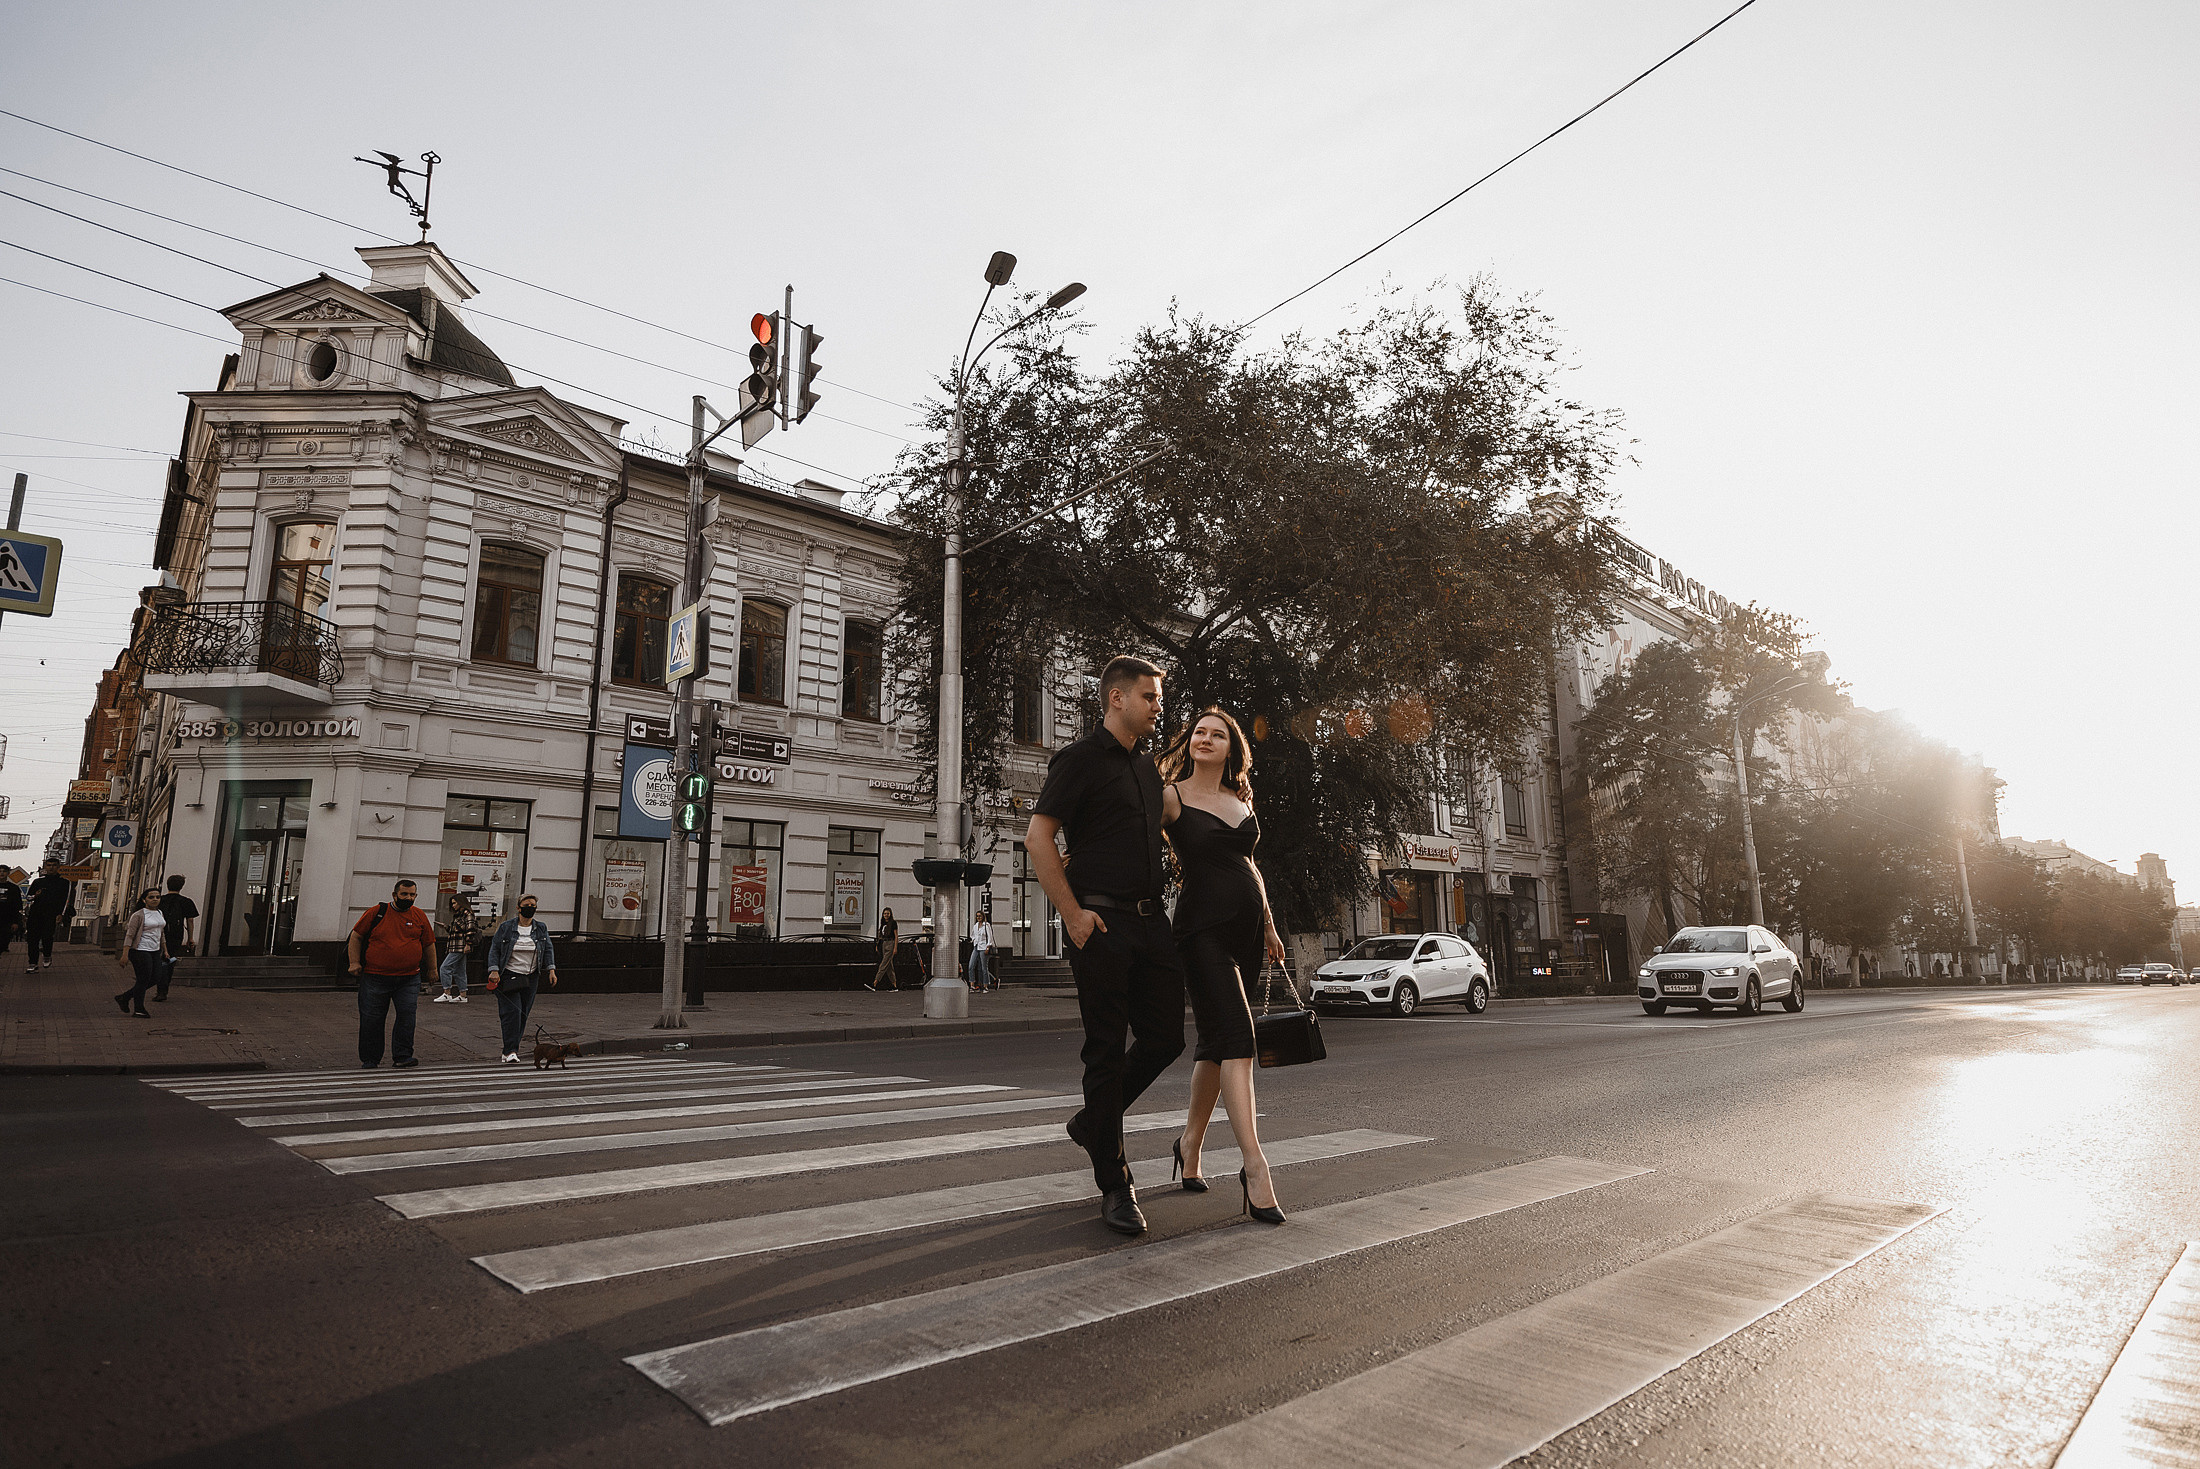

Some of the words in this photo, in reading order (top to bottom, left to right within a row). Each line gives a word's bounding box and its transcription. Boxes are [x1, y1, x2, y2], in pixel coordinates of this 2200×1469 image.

[178, 721, 217, 738] 585
[246, 716, 362, 738] ЗОЛОТОЙ
[689, 777, 703, 797] 17
[836, 877, 864, 886] ЗАЙМЫ
[733, 886, 742, 913] SALE
[742, 891, 762, 908] 80
[1532, 967, 1552, 976] SALE
